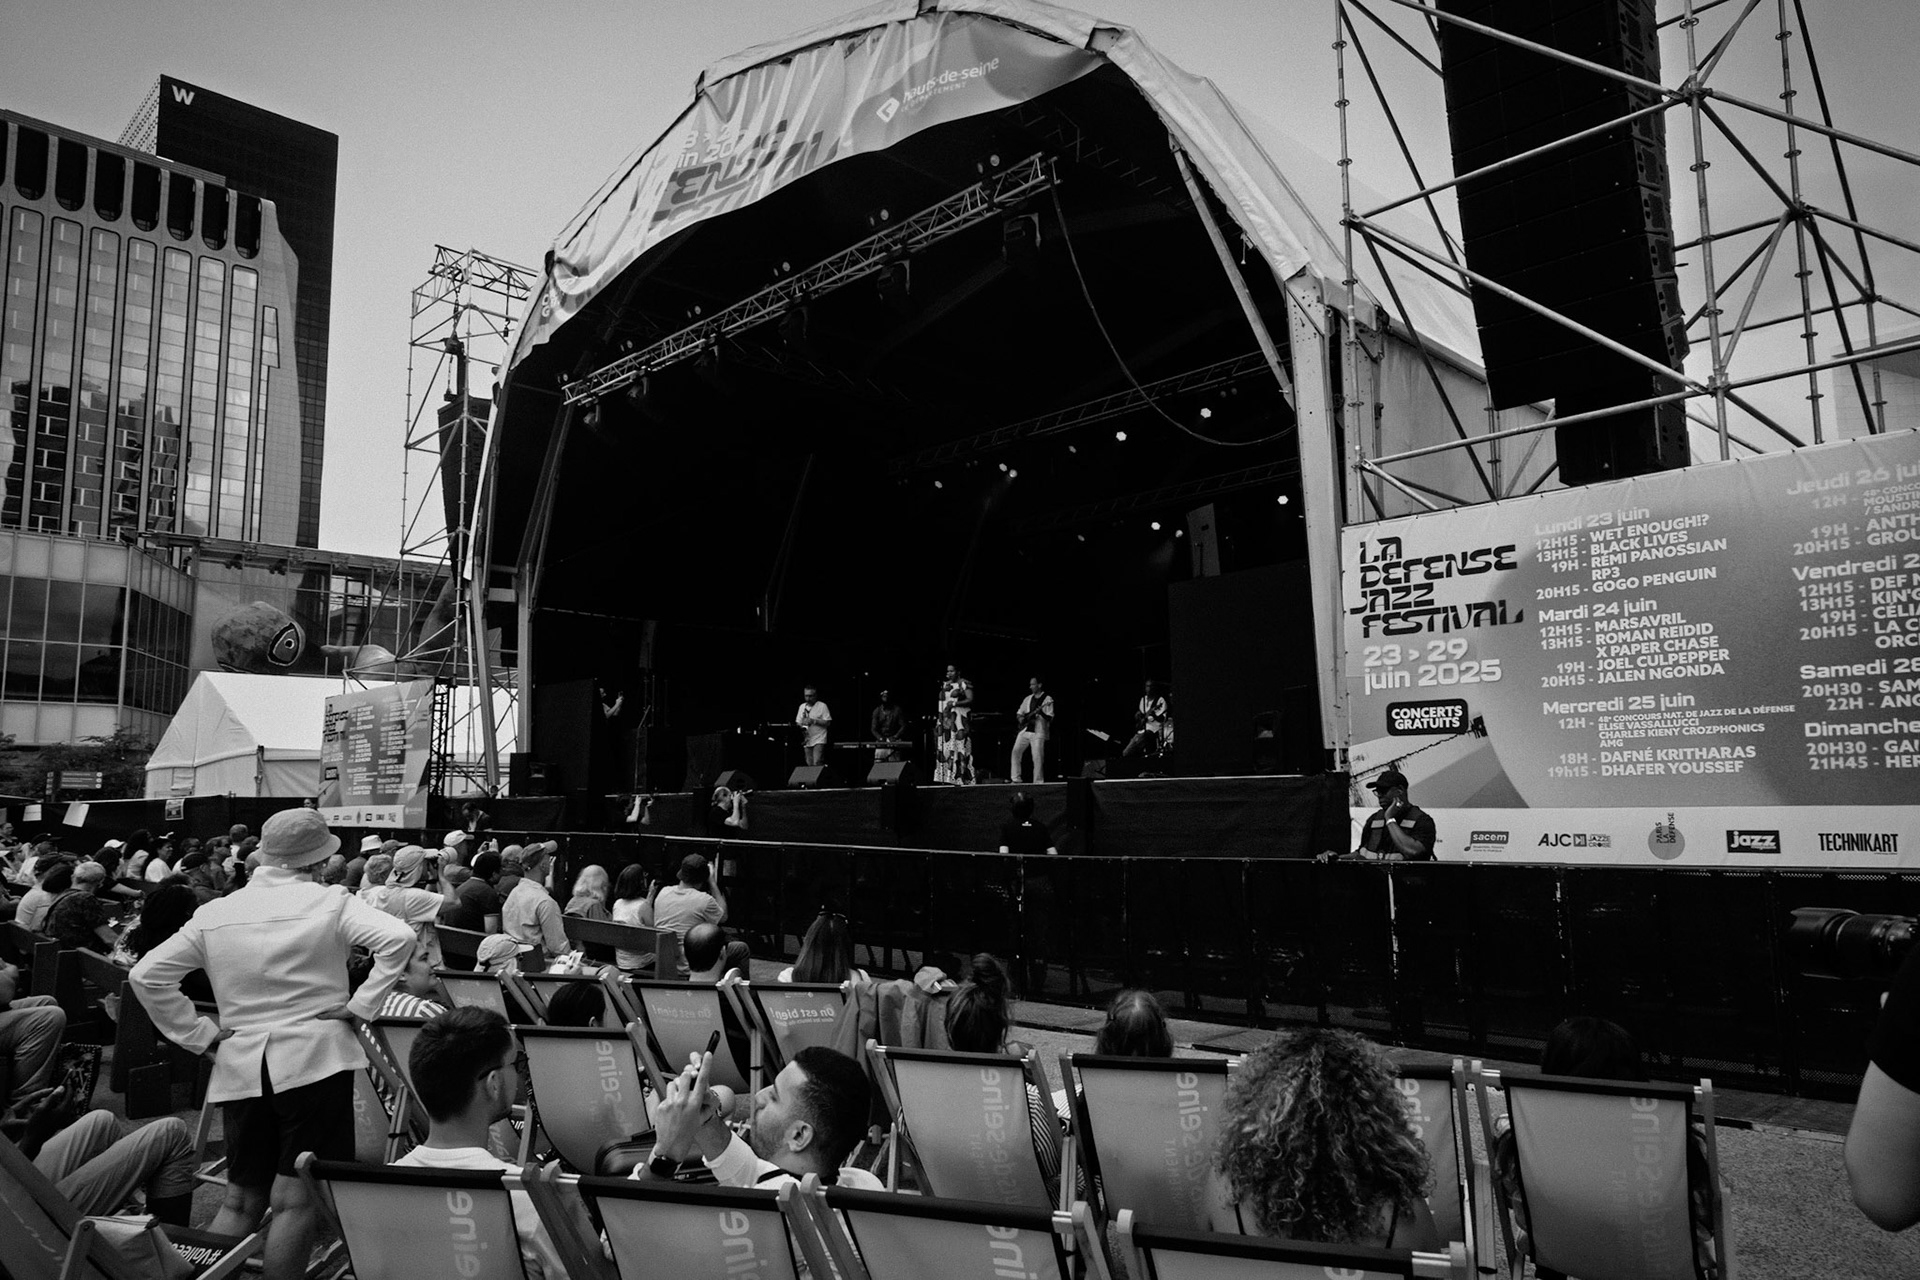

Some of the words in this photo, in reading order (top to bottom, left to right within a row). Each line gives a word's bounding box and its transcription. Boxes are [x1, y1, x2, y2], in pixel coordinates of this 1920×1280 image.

[172, 84, 195, 105] W
[1786, 472, 1850, 495] Jeudi
[1856, 467, 1890, 485] 26
[1812, 494, 1847, 509] 12H
[1535, 515, 1582, 536] Lundi
[1586, 511, 1613, 528] 23
[1617, 507, 1650, 526] juin
[1811, 523, 1847, 539] 19H
[1535, 535, 1578, 551] 12H15
[1590, 527, 1624, 543] WET
[1627, 514, 1710, 537] ENOUGH!?
[1360, 536, 1402, 564] LA
[1536, 547, 1578, 563] 13H15
[1590, 537, 1641, 556] BLACK
[1644, 531, 1688, 548] LIVES
[1551, 559, 1579, 573] 19H
[1591, 552, 1627, 568] RÉMI
[1630, 538, 1727, 562] PANOSSIAN
[1793, 537, 1850, 555] 20H15
[1592, 567, 1620, 581] RP3
[1791, 555, 1897, 580] Vendredi
[1536, 584, 1580, 600] 20H15
[1592, 577, 1639, 593] GOGO
[1643, 567, 1716, 587] PENGUIN
[1799, 580, 1853, 597] 12H15
[1870, 574, 1907, 590] DEF
[1350, 582, 1434, 615] JAZZ
[1800, 595, 1855, 611] 13H15
[1362, 600, 1523, 638] FESTIVAL
[1538, 605, 1588, 623] Mardi
[1593, 602, 1619, 618] 24
[1624, 598, 1657, 616] juin
[1820, 609, 1856, 624] 19H
[1540, 623, 1582, 638] 12H15
[1595, 612, 1686, 632] MARSAVRIL
[1799, 623, 1857, 640] 20H15
[1874, 620, 1901, 634] LA
[1540, 636, 1583, 650] 13H15
[1596, 628, 1655, 645] ROMAN
[1659, 623, 1713, 639] REIDID
[1363, 644, 1401, 667] 23
[1427, 638, 1468, 661] 29
[1596, 647, 1608, 658] X
[1611, 642, 1660, 657] PAPER
[1664, 636, 1719, 652] CHASE
[1557, 661, 1584, 674] 19H
[1597, 658, 1633, 671] JOEL
[1637, 649, 1730, 667] CULPEPPER
[1800, 659, 1887, 679] Samedi
[1365, 666, 1410, 695] juin
[1418, 659, 1501, 686] 2025
[1541, 674, 1585, 688] 20H15
[1598, 669, 1645, 684] JALEN
[1649, 663, 1725, 680] NGONDA
[1802, 682, 1862, 698] 20H30
[1391, 705, 1463, 719] CONCERTS
[1543, 697, 1623, 715] Mercredi
[1628, 695, 1656, 710] 25
[1660, 692, 1695, 711] juin
[1826, 697, 1864, 711] 22H
[1394, 717, 1460, 730] GRATUITS
[1558, 717, 1586, 729] 12H
[1613, 712, 1661, 722] CONCOURS
[1663, 711, 1684, 719] NAT.
[1686, 710, 1697, 718] DE
[1699, 709, 1722, 717] JAZZ
[1724, 708, 1736, 716] DE
[1738, 707, 1751, 715] LA
[1626, 718, 1699, 729] VASSALLUCCI
[1804, 718, 1920, 737] Dimanche
[1599, 729, 1646, 739] CHARLES
[1648, 727, 1680, 737] KIENY
[1682, 723, 1765, 735] CROZPHONICS
[1600, 739, 1623, 747] AMG
[1806, 741, 1867, 755] 20H30
[1560, 753, 1588, 765] 18H
[1600, 747, 1653, 763] DAFNÉ
[1657, 746, 1756, 762] KRITHARAS
[1809, 756, 1868, 770] 21H45
[1548, 766, 1589, 778] 19h15
[1601, 763, 1665, 777] DHAFER
[1668, 760, 1744, 774] YOUSSEF
[1473, 832, 1507, 841] sacem
[1538, 833, 1572, 847] AJC
[1730, 830, 1776, 848] jazz
[1818, 833, 1898, 852] TECHNIKART
